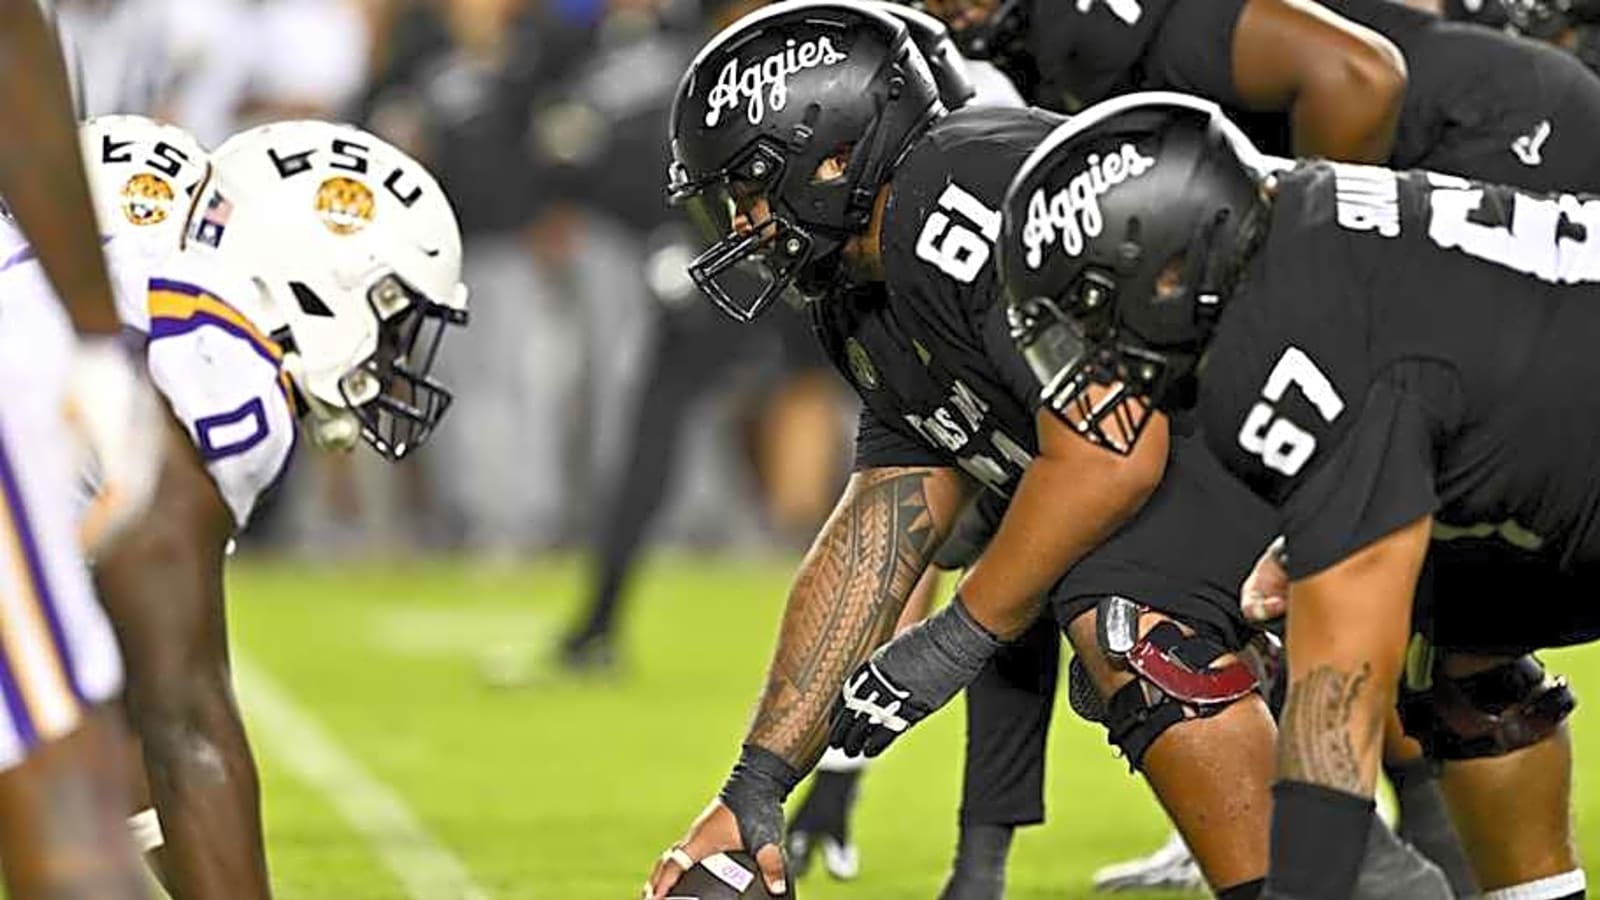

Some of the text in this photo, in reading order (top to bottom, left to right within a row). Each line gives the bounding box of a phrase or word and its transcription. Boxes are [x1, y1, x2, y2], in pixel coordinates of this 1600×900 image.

[705, 36, 848, 127] Aggies
[102, 134, 200, 199] LS
[1023, 143, 1155, 269] Aggies
[916, 183, 1001, 283] 61
[1238, 346, 1345, 476] 67
